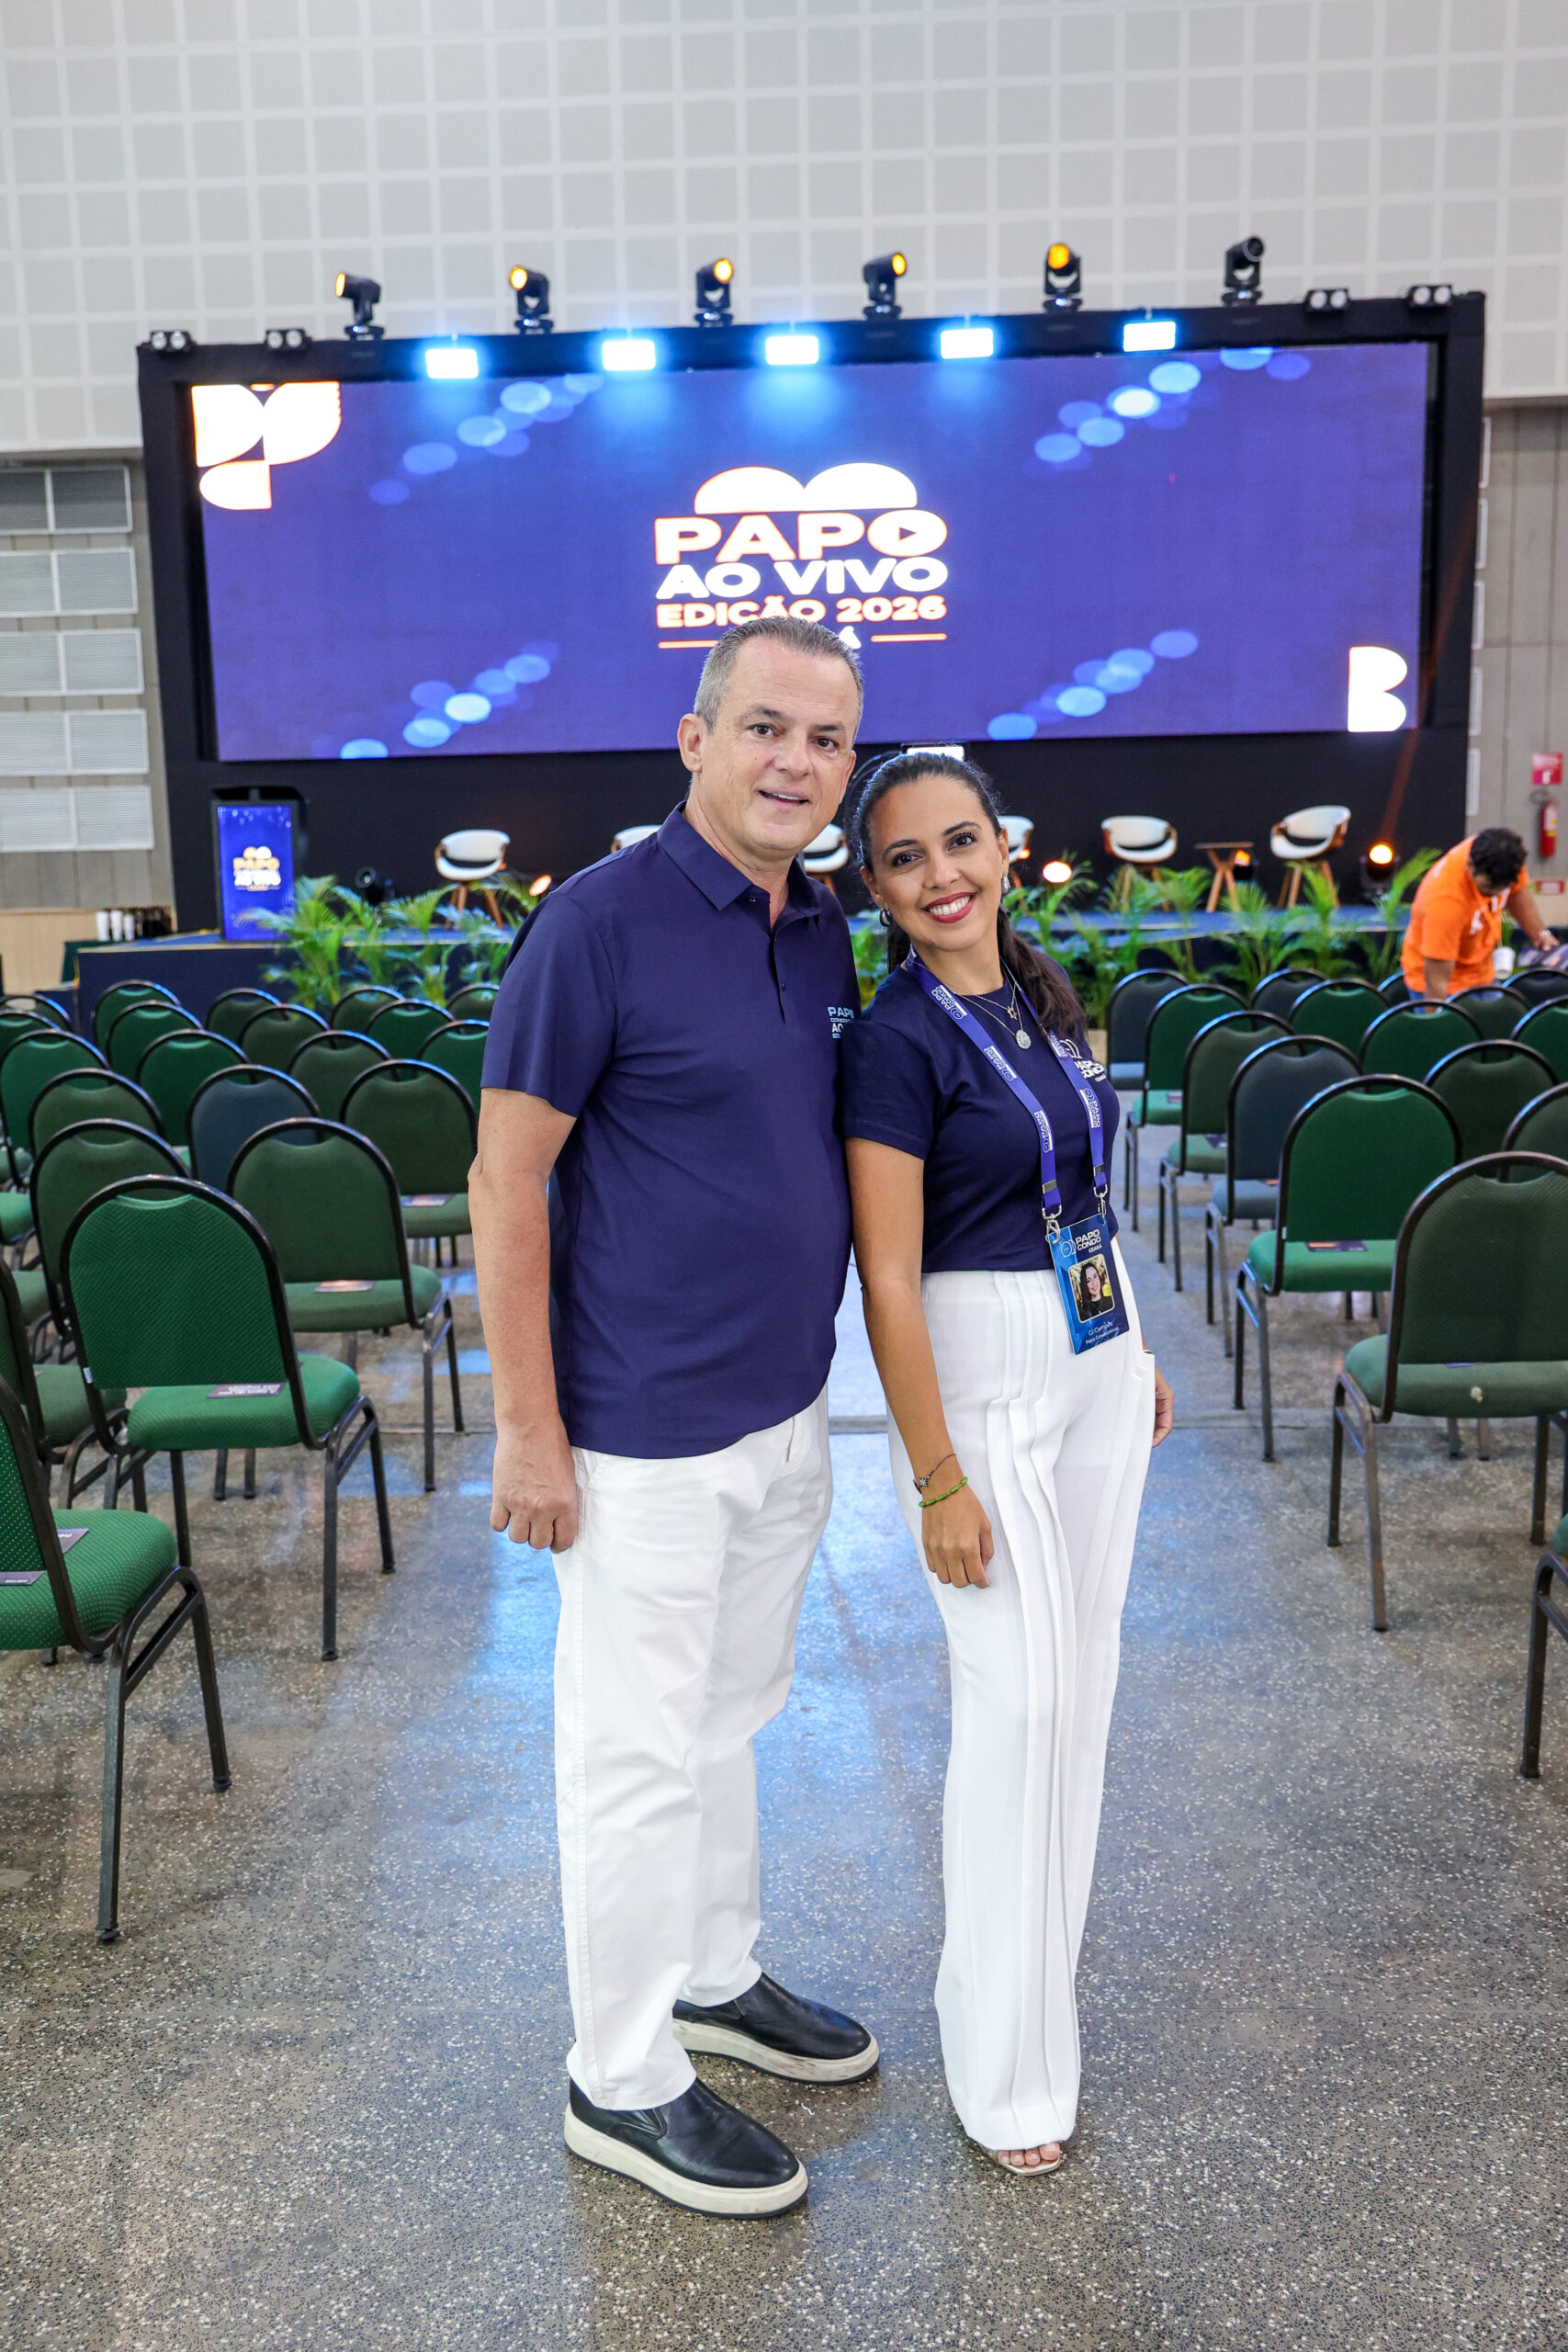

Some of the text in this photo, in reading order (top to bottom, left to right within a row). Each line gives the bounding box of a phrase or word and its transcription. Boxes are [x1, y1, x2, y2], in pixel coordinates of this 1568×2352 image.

[655, 509, 948, 565] PAPO
[656, 557, 948, 599] AO VIVO
[836, 594, 947, 623] 2026
[931, 989, 952, 1011] PAPO
[935, 986, 954, 1008] CONDO
[1076, 1229, 1100, 1245] PAPO
[1077, 1237, 1101, 1250] CONDO
